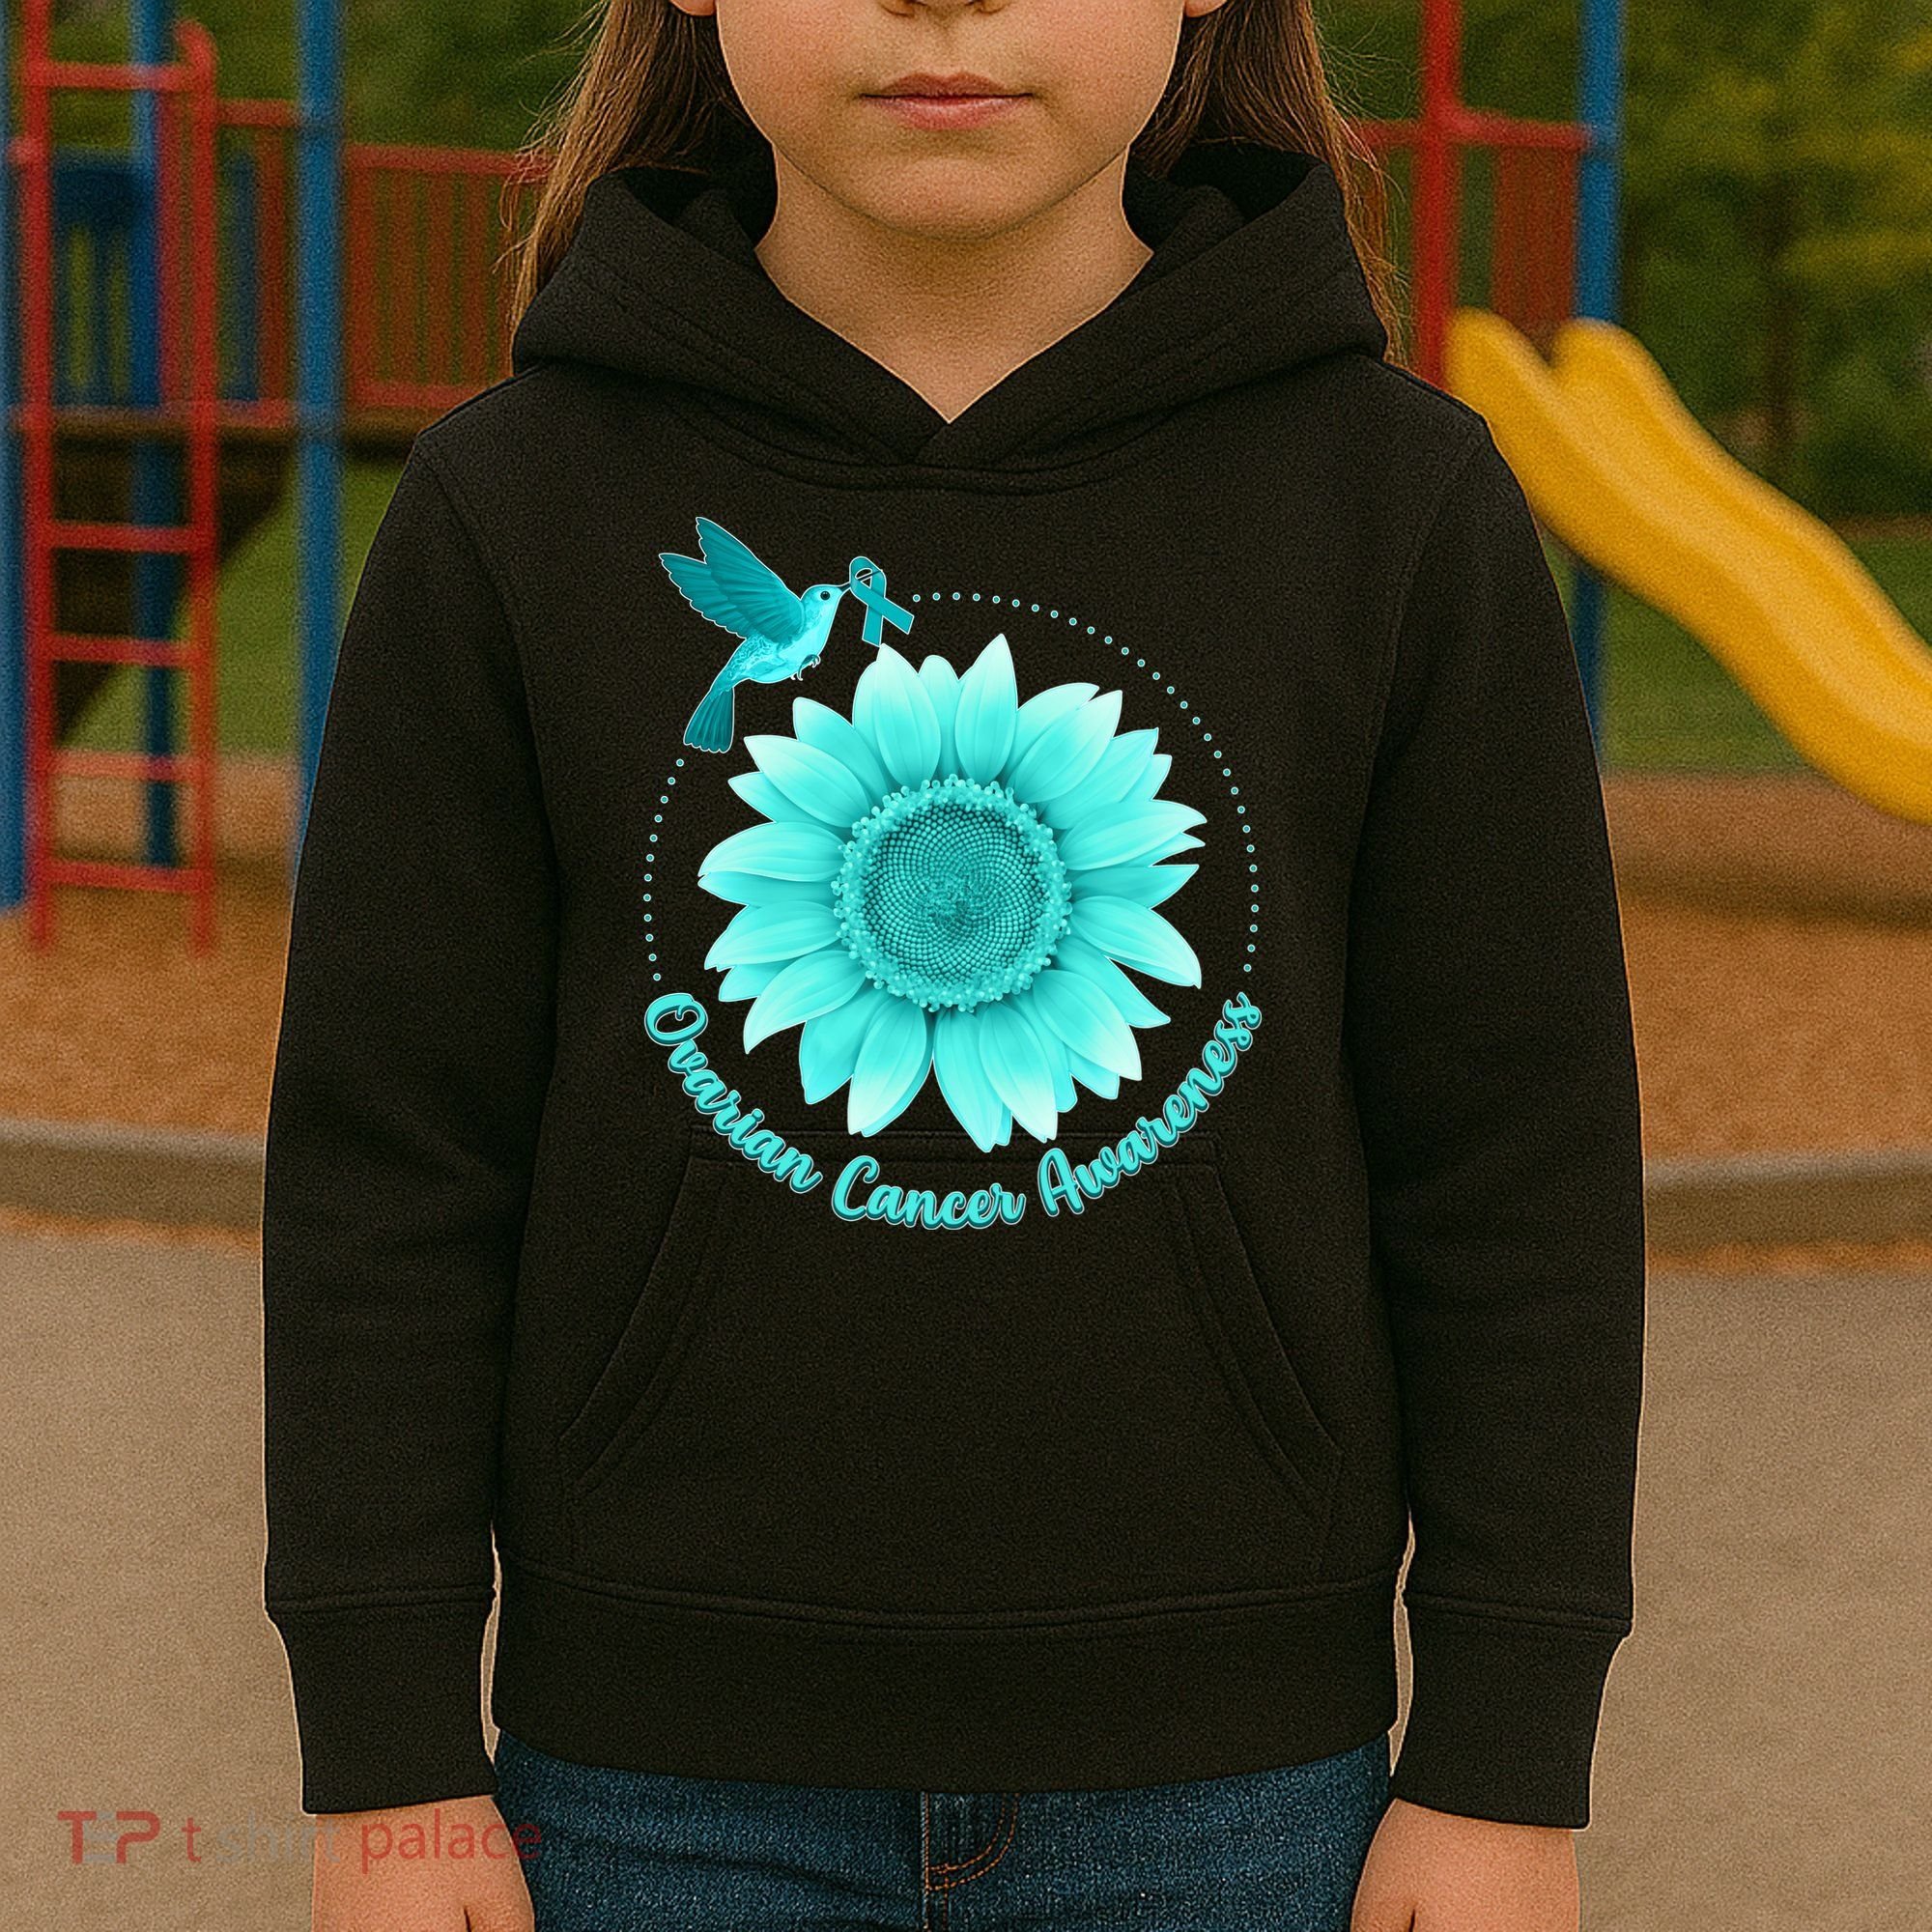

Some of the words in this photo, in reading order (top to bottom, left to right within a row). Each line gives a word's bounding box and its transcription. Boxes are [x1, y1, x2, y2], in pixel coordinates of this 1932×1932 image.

[645, 993, 822, 1194] Ovarian
[833, 1155, 1026, 1230] Cancer
[1038, 992, 1262, 1216] Awareness
